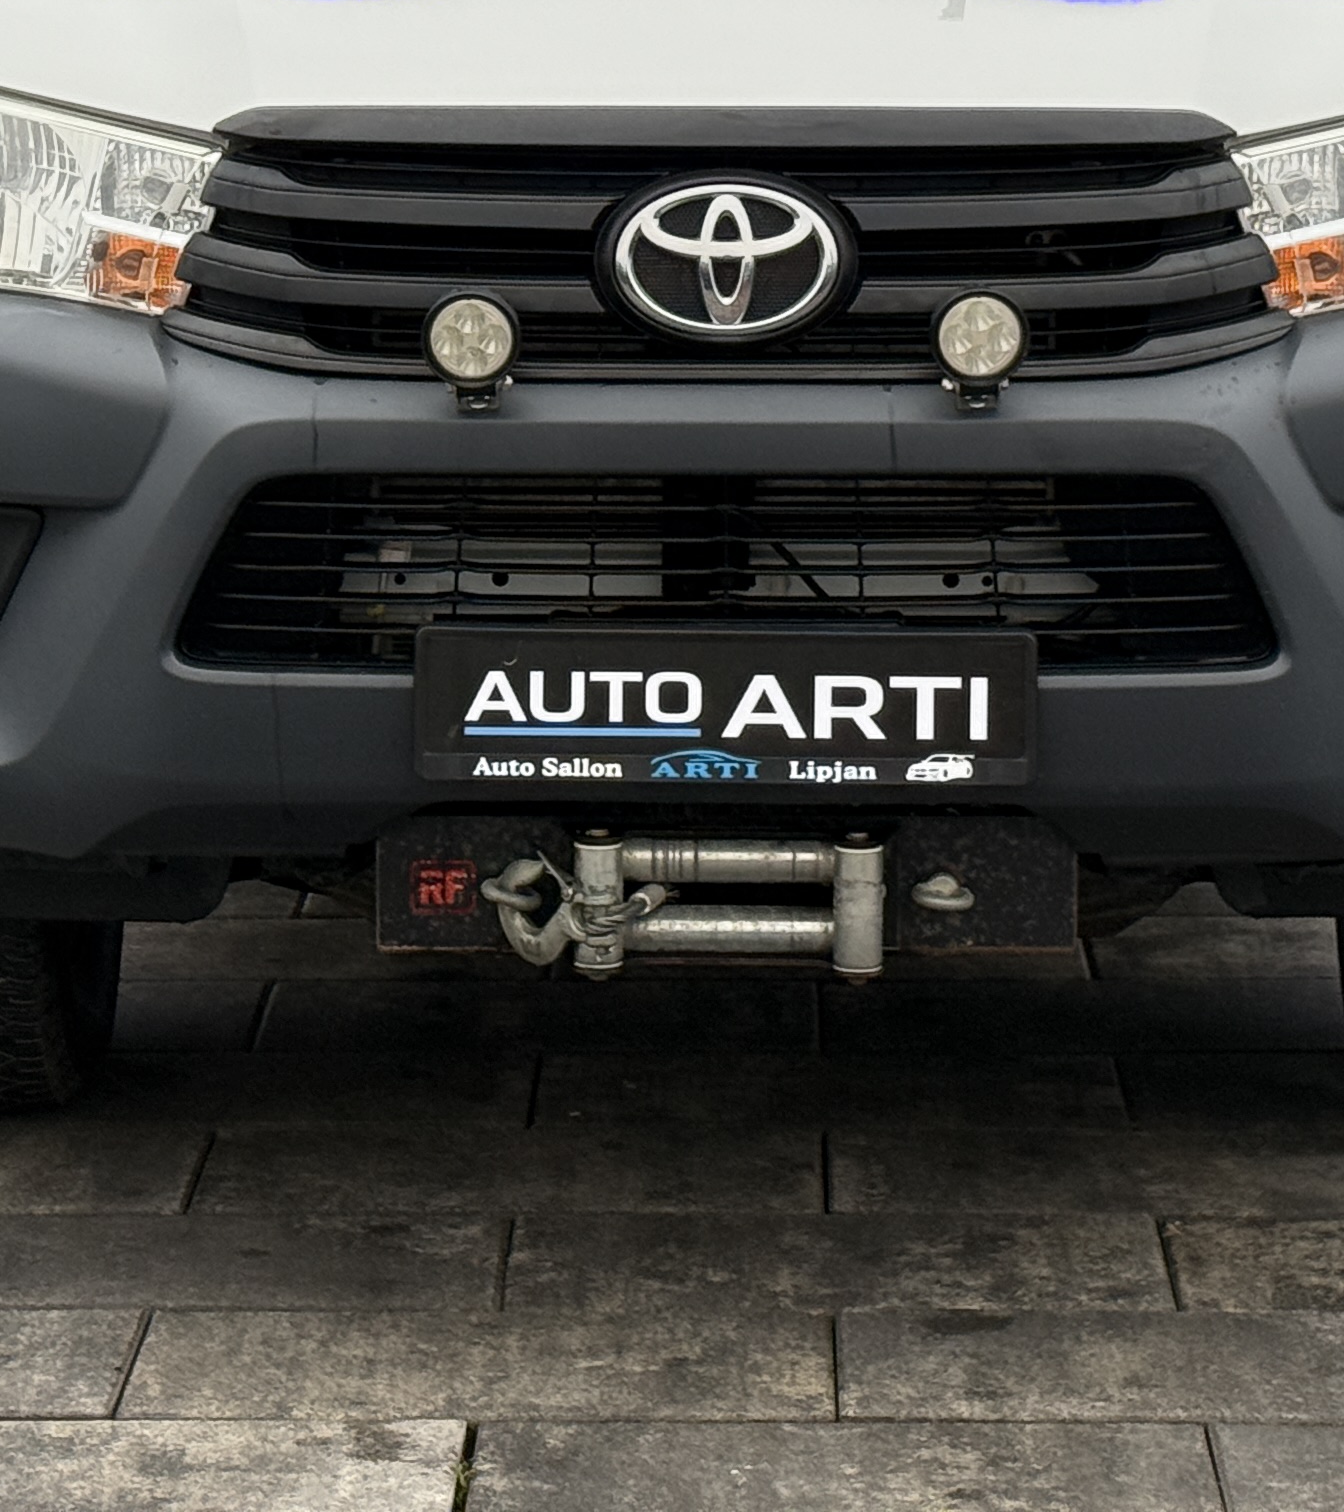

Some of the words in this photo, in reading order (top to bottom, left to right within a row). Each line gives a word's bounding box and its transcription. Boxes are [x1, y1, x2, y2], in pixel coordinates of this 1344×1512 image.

[463, 670, 703, 724] AUTO
[720, 674, 990, 741] ARTI
[472, 756, 536, 777] Auto
[541, 757, 623, 778] Sallon
[650, 761, 759, 779] ARTI
[788, 760, 878, 783] Lipjan
